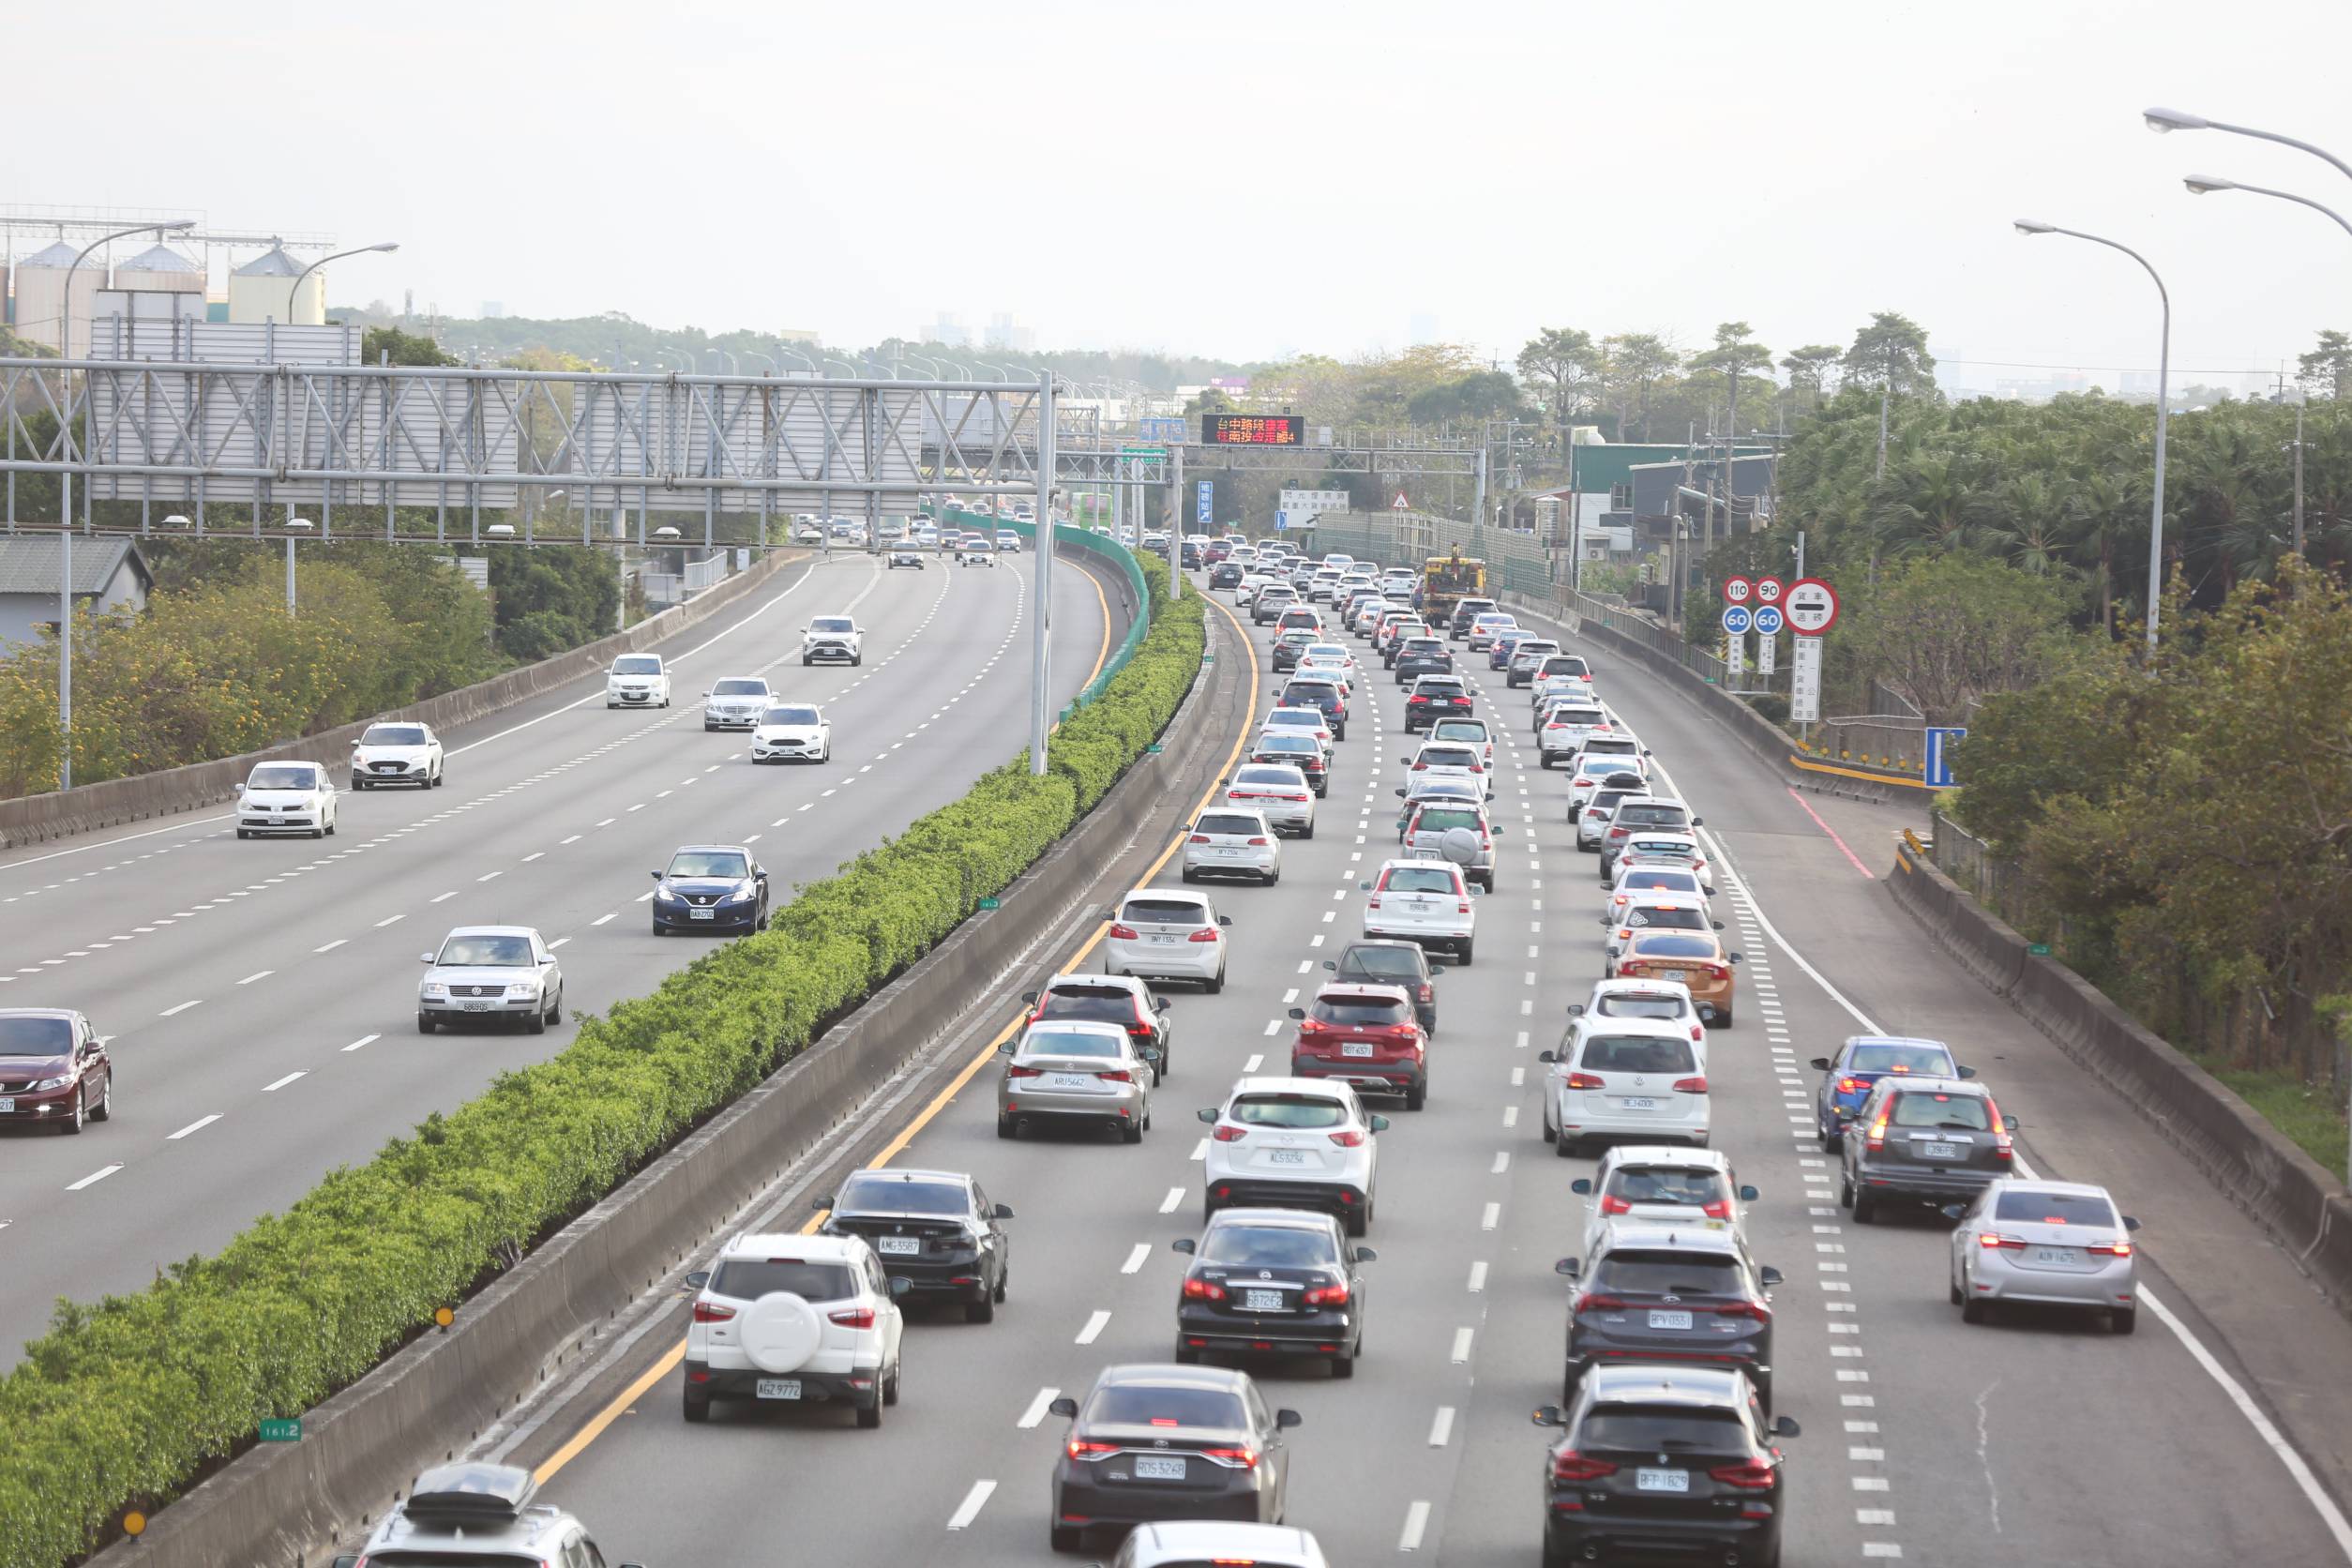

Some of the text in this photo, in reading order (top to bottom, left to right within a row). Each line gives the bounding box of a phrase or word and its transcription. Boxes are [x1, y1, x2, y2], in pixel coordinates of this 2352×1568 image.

[1730, 584, 1747, 596] 110
[1761, 585, 1778, 596] 90
[1727, 614, 1747, 626] 60
[1758, 614, 1778, 626] 60
[266, 1425, 298, 1436] 161.2
